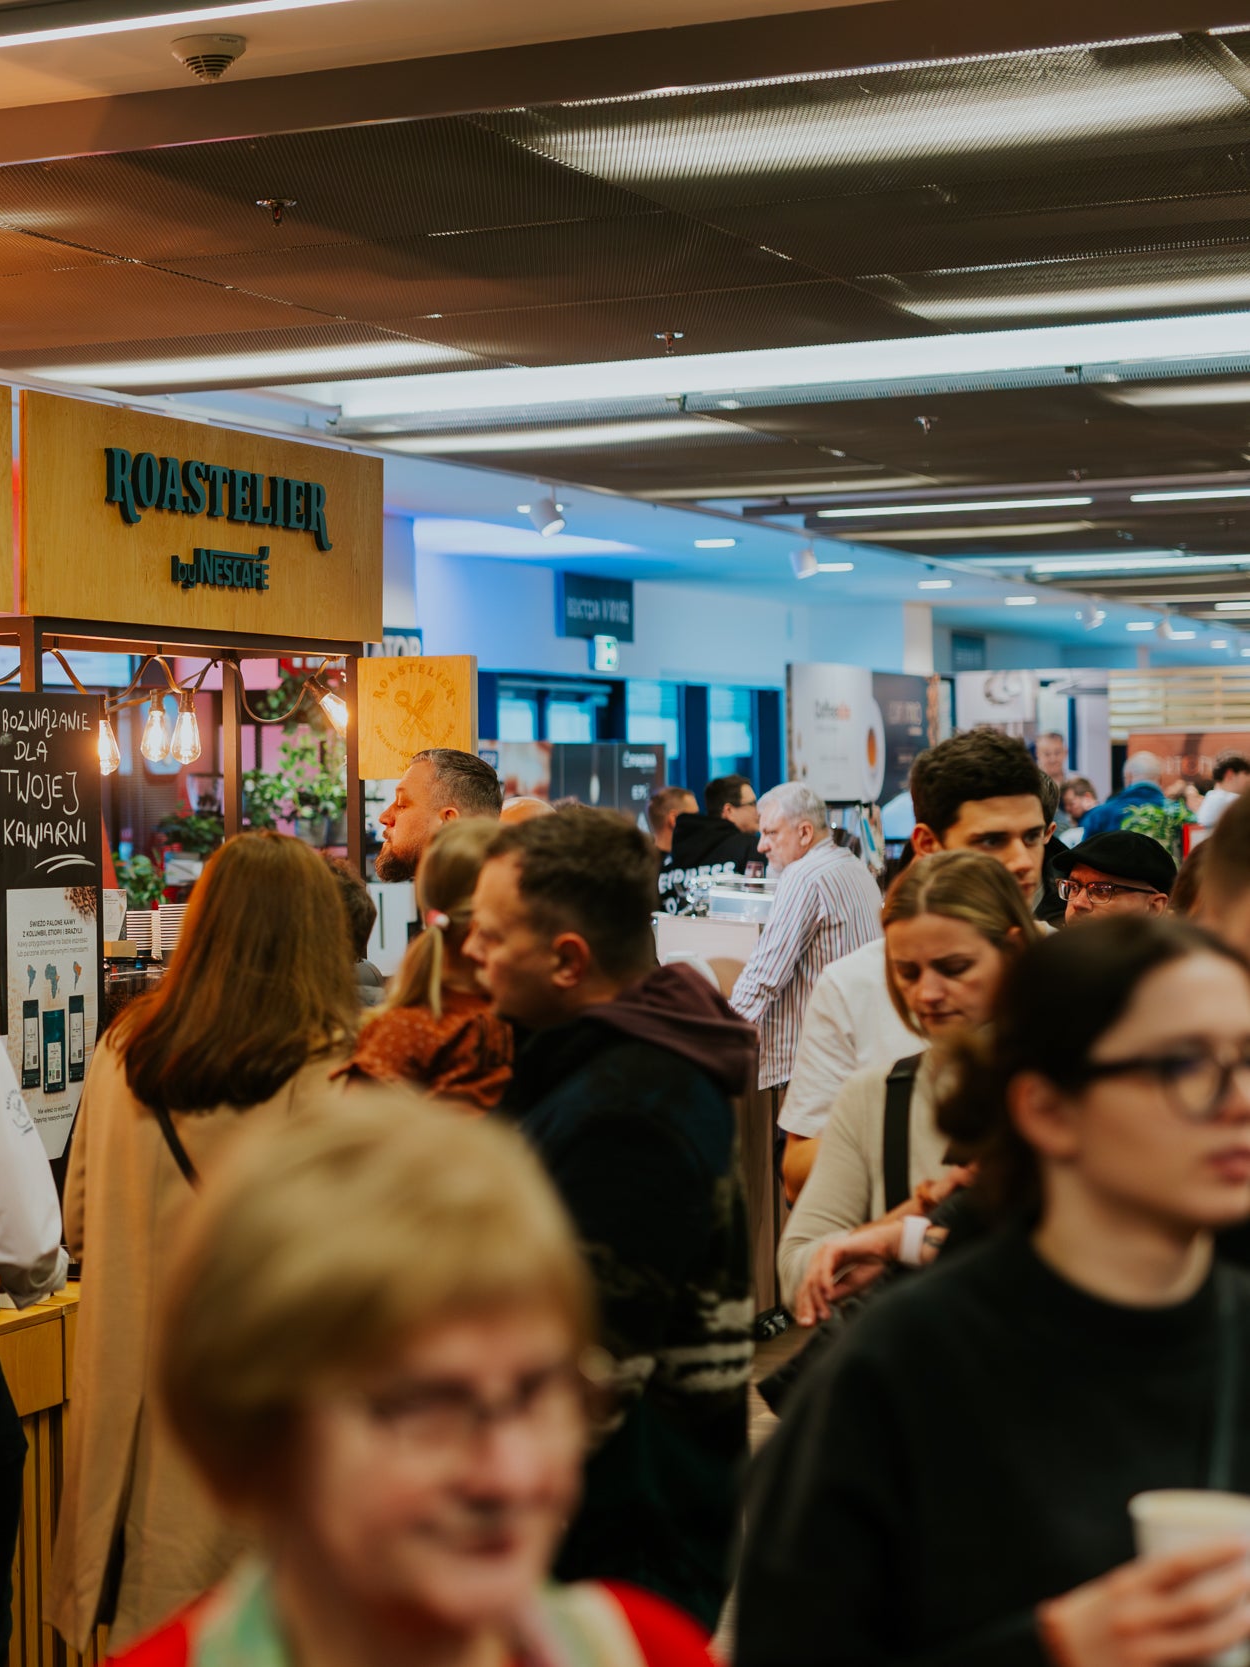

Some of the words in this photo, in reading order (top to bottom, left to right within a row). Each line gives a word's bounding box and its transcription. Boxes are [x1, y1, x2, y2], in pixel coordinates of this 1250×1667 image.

[104, 447, 333, 552] ROASTELIER
[171, 555, 197, 589] by
[372, 663, 457, 701] ROASTELIER
[2, 708, 92, 738] ROZWIĄZANIE
[13, 740, 48, 762] DLA
[0, 769, 80, 815] TWOJEJ
[3, 818, 87, 849] KAWIARNI
[46, 919, 63, 927] PALONE
[63, 918, 76, 926] KAWY
